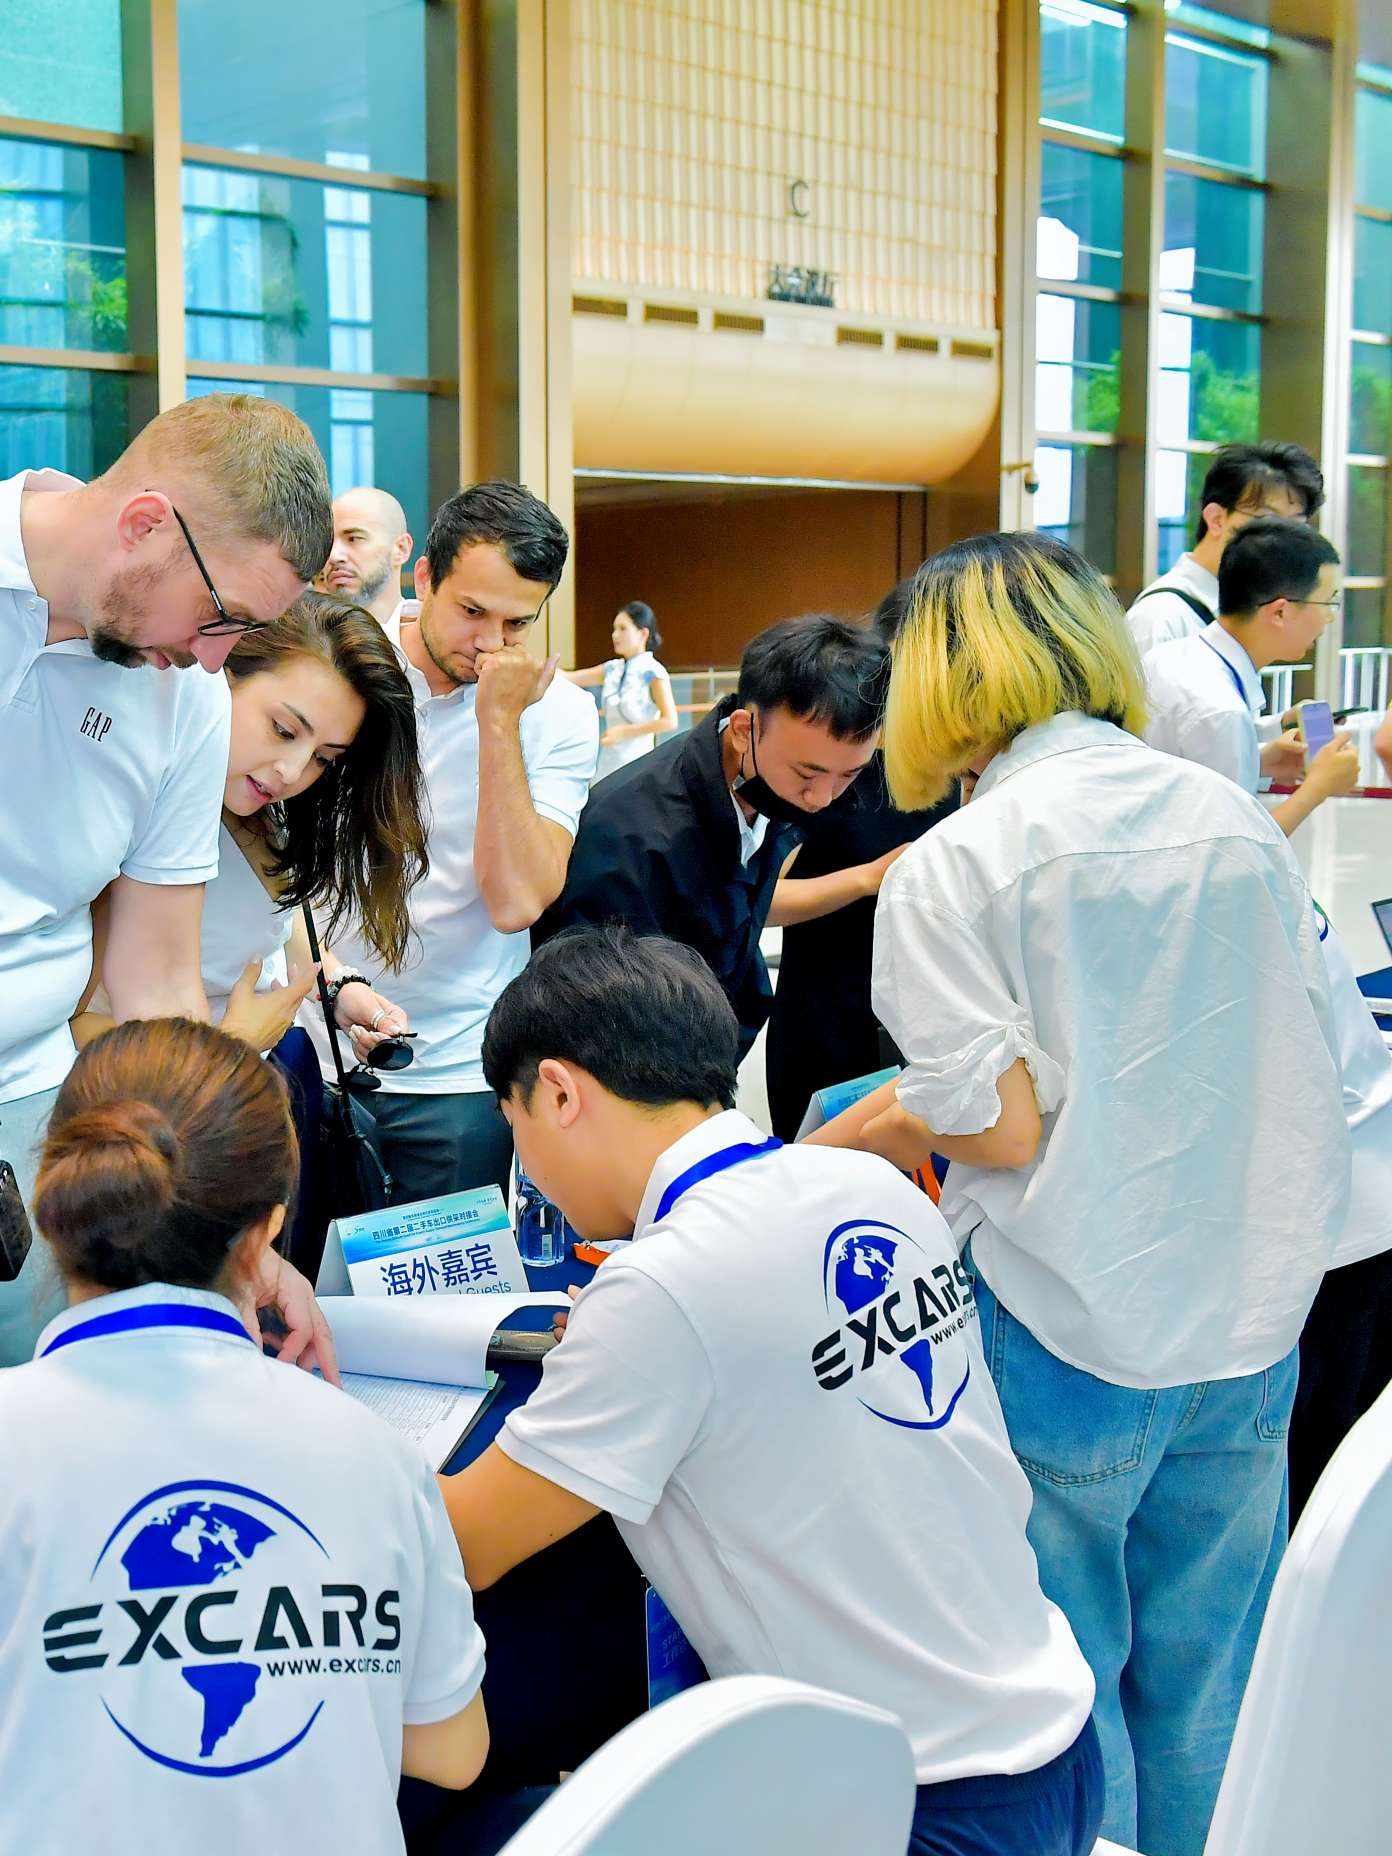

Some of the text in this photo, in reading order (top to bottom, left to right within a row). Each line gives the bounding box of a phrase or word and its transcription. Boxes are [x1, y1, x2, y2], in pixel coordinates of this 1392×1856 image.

[791, 179, 810, 218] C
[80, 706, 113, 743] GAP
[379, 1242, 498, 1296] 海外嘉宾
[811, 1259, 975, 1391] EXCARS
[42, 1584, 401, 1673] EXCARS
